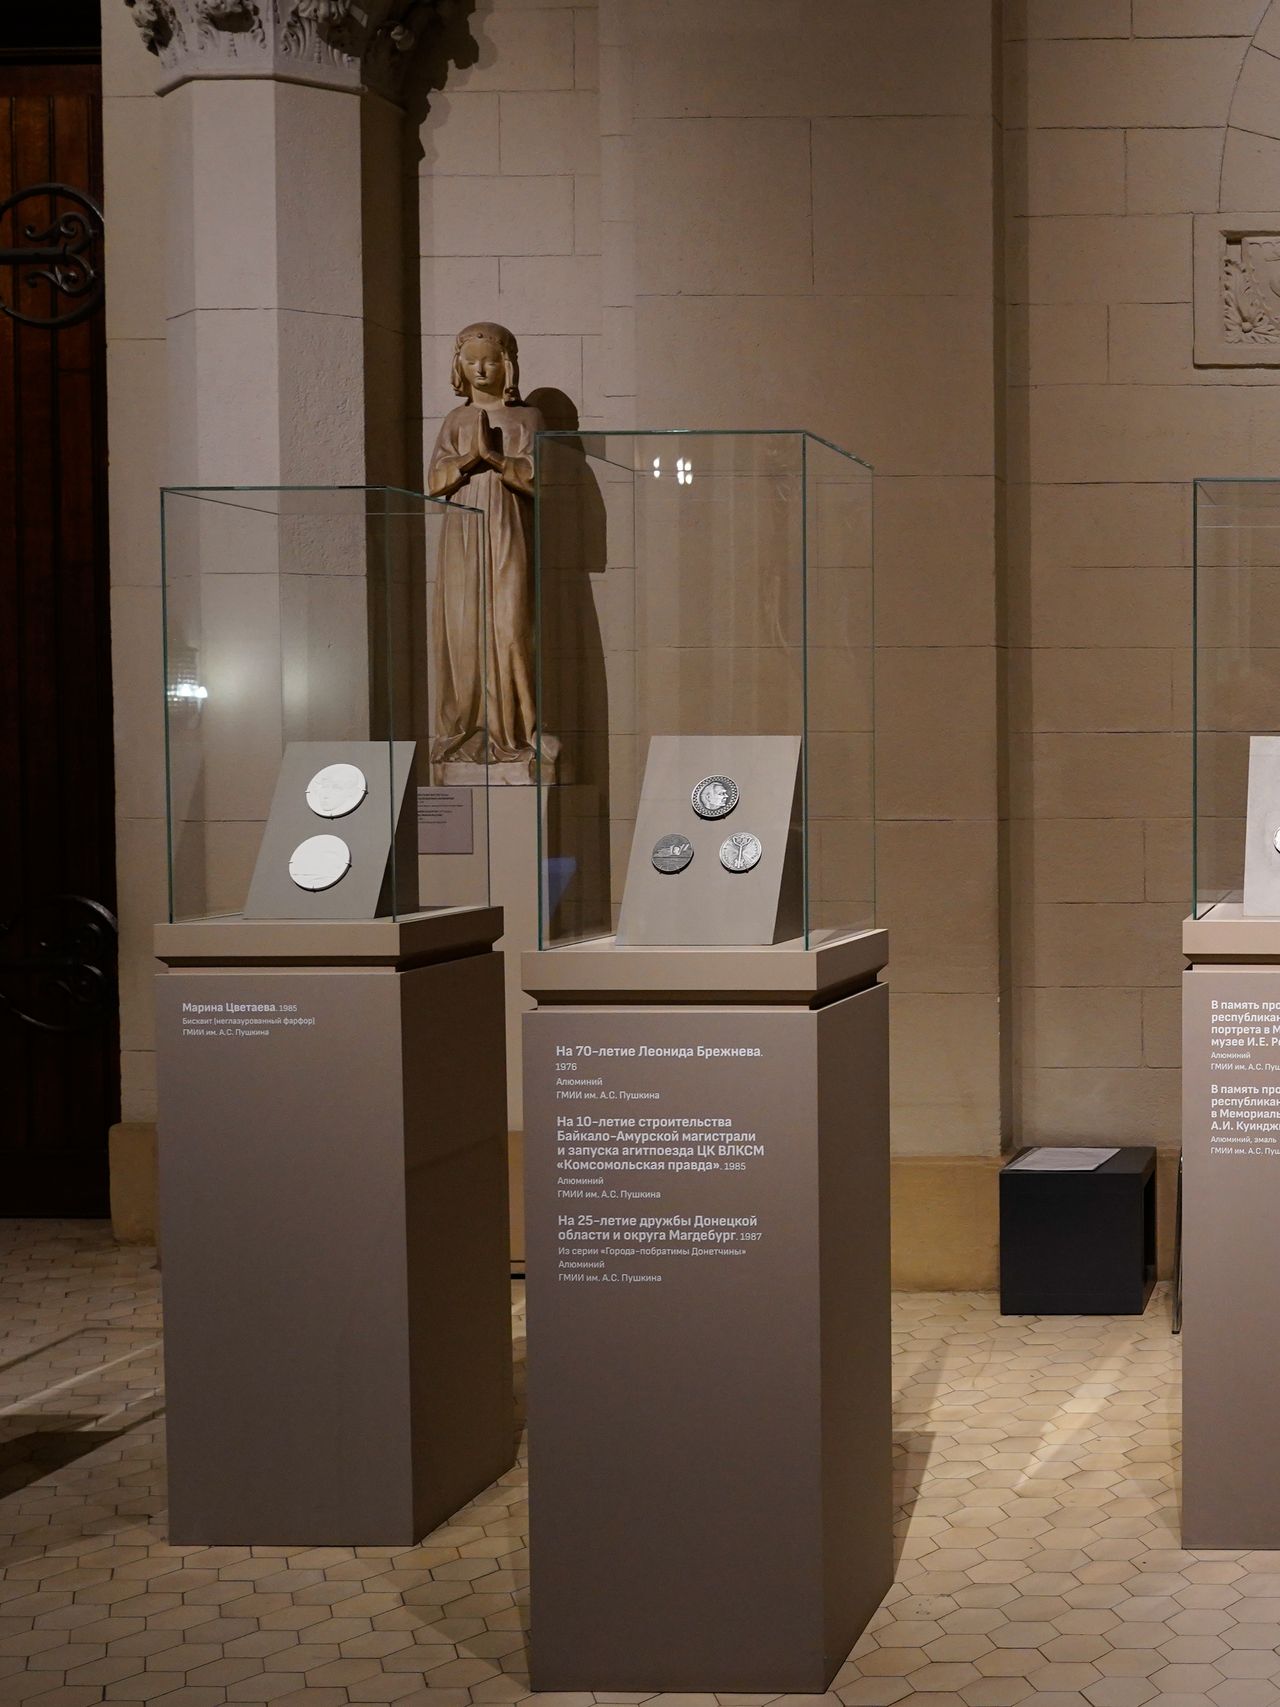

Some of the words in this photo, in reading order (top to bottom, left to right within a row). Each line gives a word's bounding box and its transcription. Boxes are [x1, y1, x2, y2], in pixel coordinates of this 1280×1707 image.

[182, 1003, 223, 1014] Марина
[1211, 1000, 1218, 1009] В
[1221, 1001, 1259, 1010] память
[214, 1017, 282, 1025] (неглазурованный
[235, 1029, 269, 1037] Пушкина
[1211, 1026, 1261, 1035] портрета
[1211, 1038, 1244, 1048] музее
[1247, 1037, 1268, 1046] И.Е.
[556, 1046, 572, 1057] На
[638, 1046, 693, 1058] Леонида
[556, 1063, 577, 1071] 1976
[556, 1077, 602, 1085] Алюминий
[1211, 1085, 1218, 1093] В
[1221, 1086, 1259, 1094] память
[556, 1091, 582, 1099] ГМИИ
[600, 1091, 617, 1099] А.С.
[619, 1091, 660, 1100] Пушкина
[557, 1117, 573, 1126] На
[638, 1118, 731, 1129] строительства
[1211, 1122, 1233, 1130] А.И.
[683, 1133, 756, 1143] магистрали
[1211, 1136, 1252, 1144] Алюминий,
[558, 1147, 565, 1155] и
[568, 1147, 619, 1157] запуска
[622, 1147, 694, 1157] агитпоезда
[697, 1146, 715, 1157] ЦК
[719, 1146, 764, 1156] ВЛКСМ
[557, 1160, 664, 1170] «Комсомольская
[724, 1162, 746, 1170] 1985
[558, 1176, 604, 1185] Алюминий
[558, 1190, 583, 1198] ГМИИ
[601, 1190, 618, 1198] А.С.
[620, 1190, 661, 1199] Пушкина
[558, 1216, 574, 1226] На
[640, 1215, 691, 1228] дружбы
[694, 1215, 758, 1228] Донецкой
[558, 1230, 610, 1240] области
[613, 1231, 620, 1240] и
[624, 1231, 666, 1242] округа
[558, 1247, 569, 1255] Из
[572, 1248, 598, 1256] серии
[692, 1248, 746, 1256] Донетчины»
[559, 1260, 604, 1268] Алюминий
[622, 1274, 661, 1283] Пушкина
